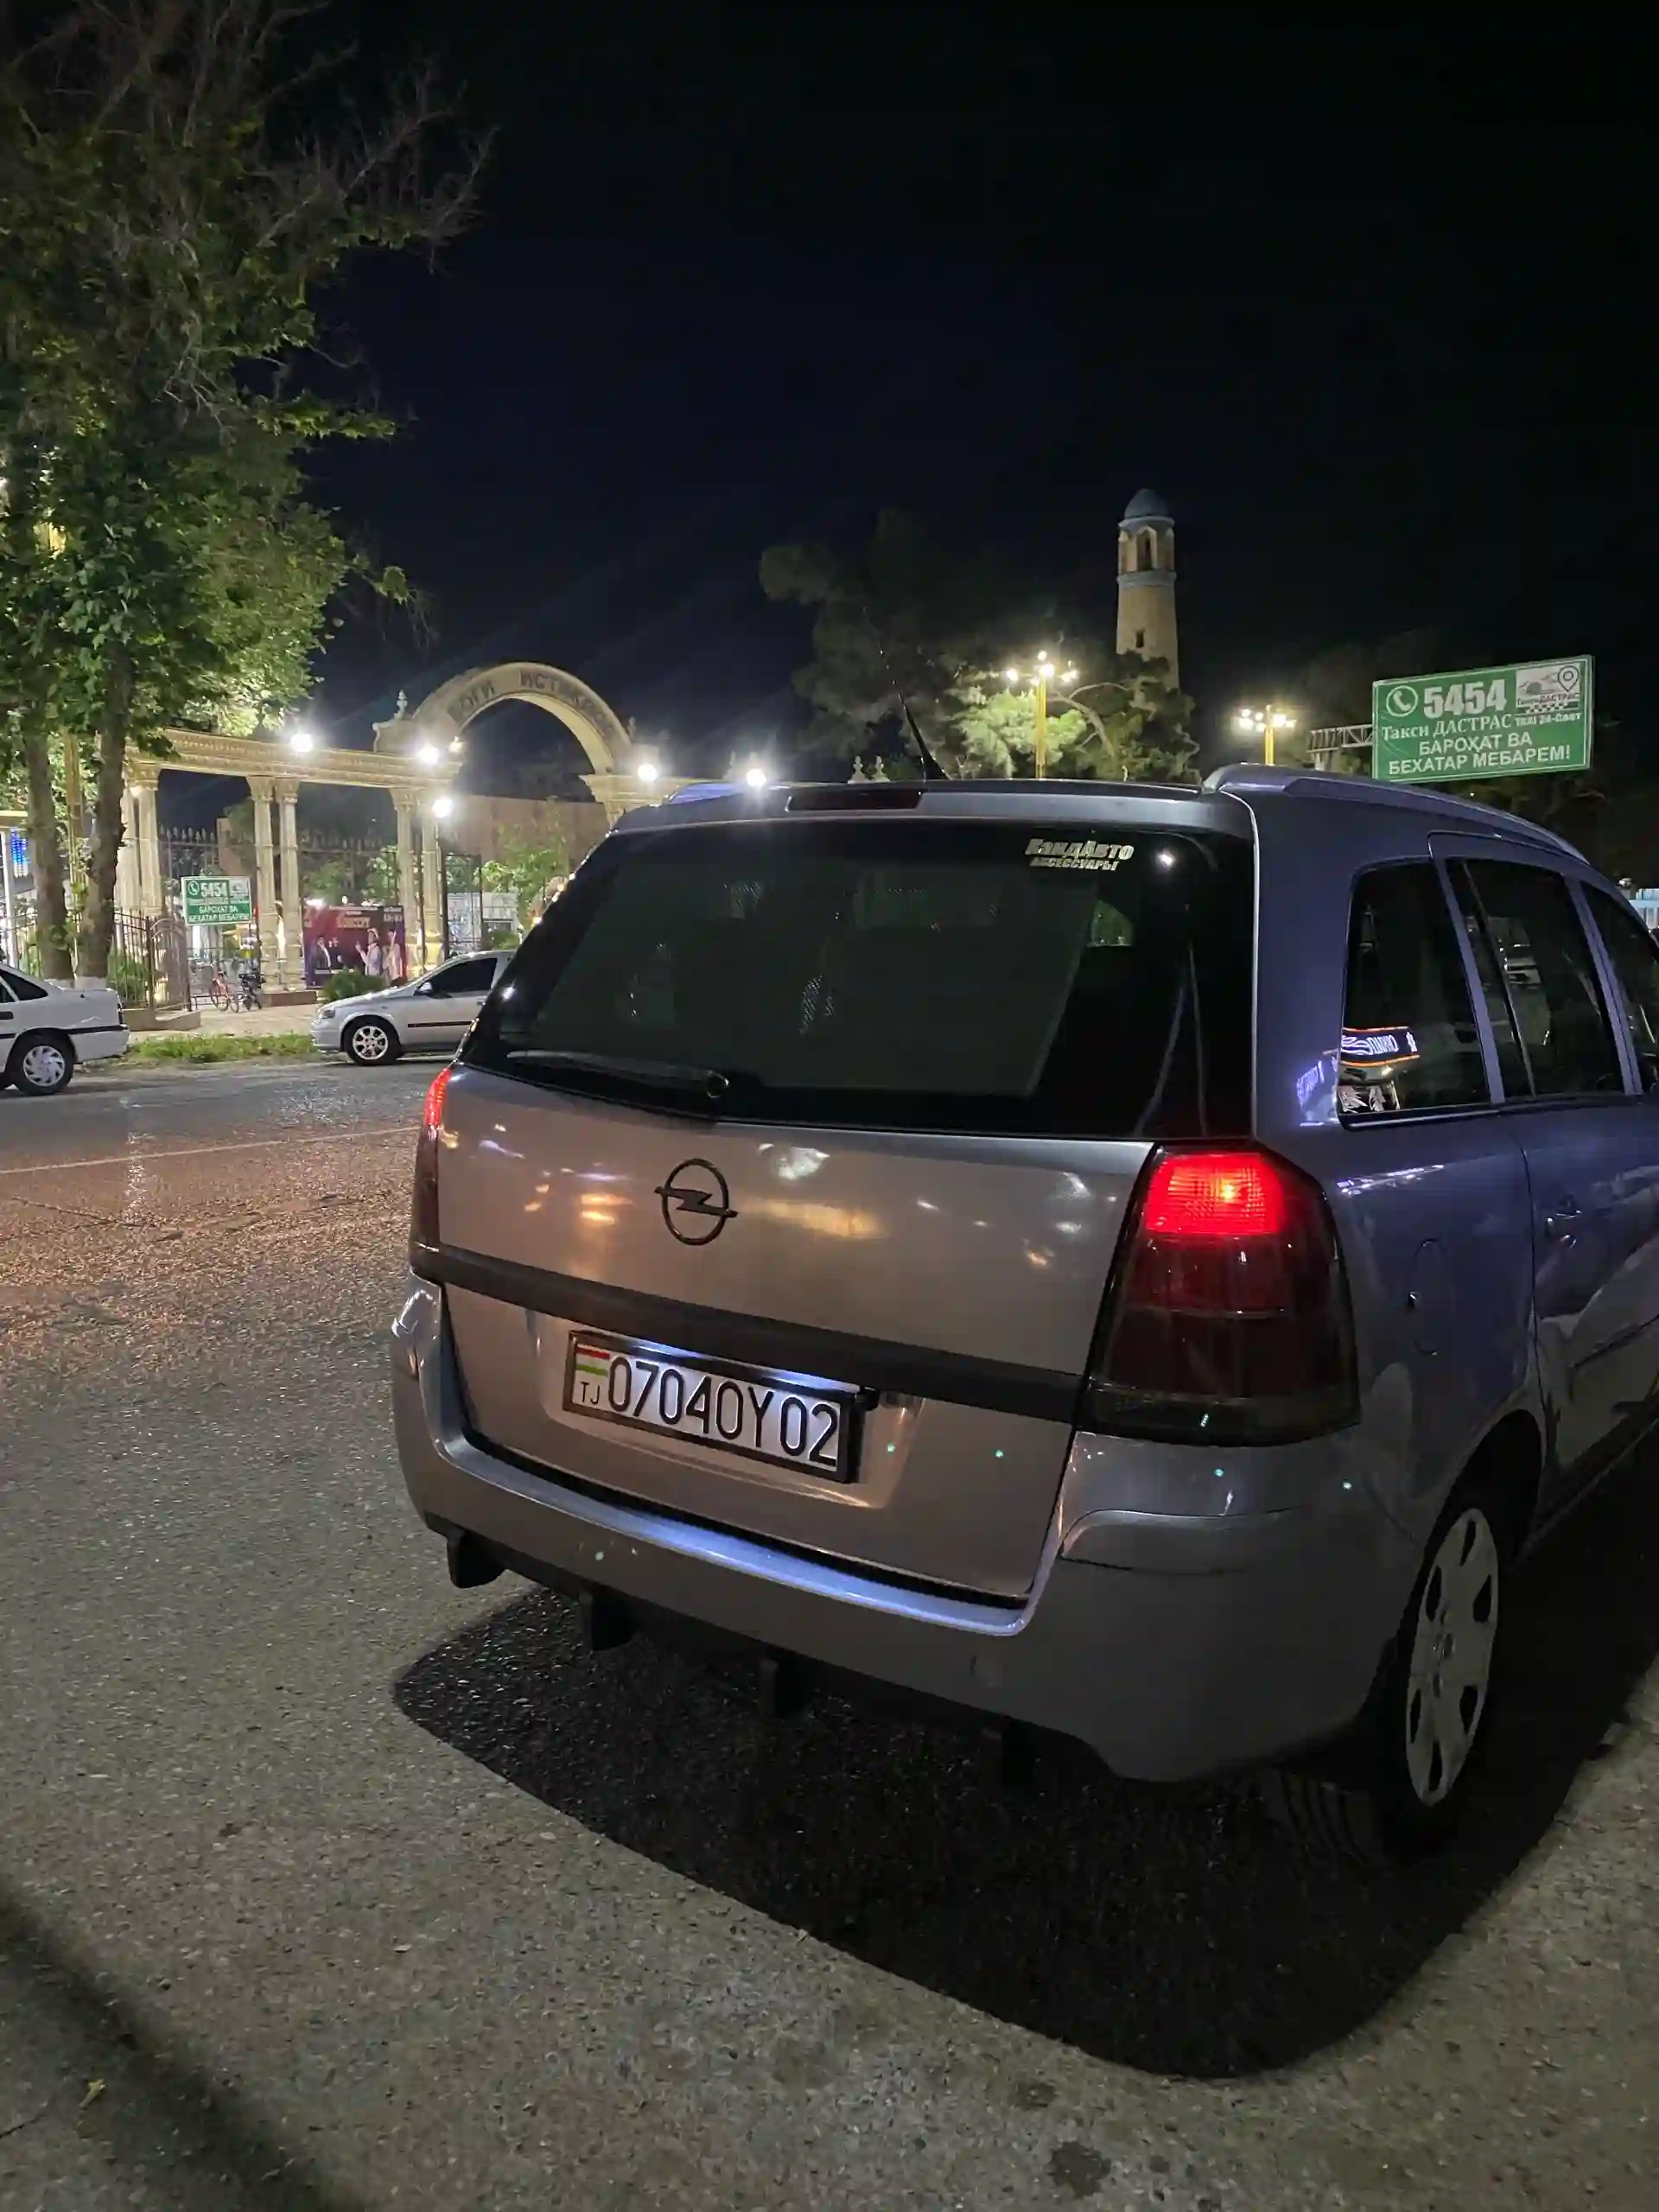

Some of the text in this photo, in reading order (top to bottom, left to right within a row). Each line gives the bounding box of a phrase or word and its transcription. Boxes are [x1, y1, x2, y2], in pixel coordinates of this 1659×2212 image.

[1423, 679, 1507, 719] 5454
[1382, 725, 1429, 741] Такси
[1433, 714, 1511, 738] ДАСТРАС
[1508, 731, 1533, 747] ВА
[1389, 745, 1571, 775] БЕХАТАР МЕБАРЕМ!
[200, 881, 228, 897] 5454
[580, 1381, 601, 1406] TJ
